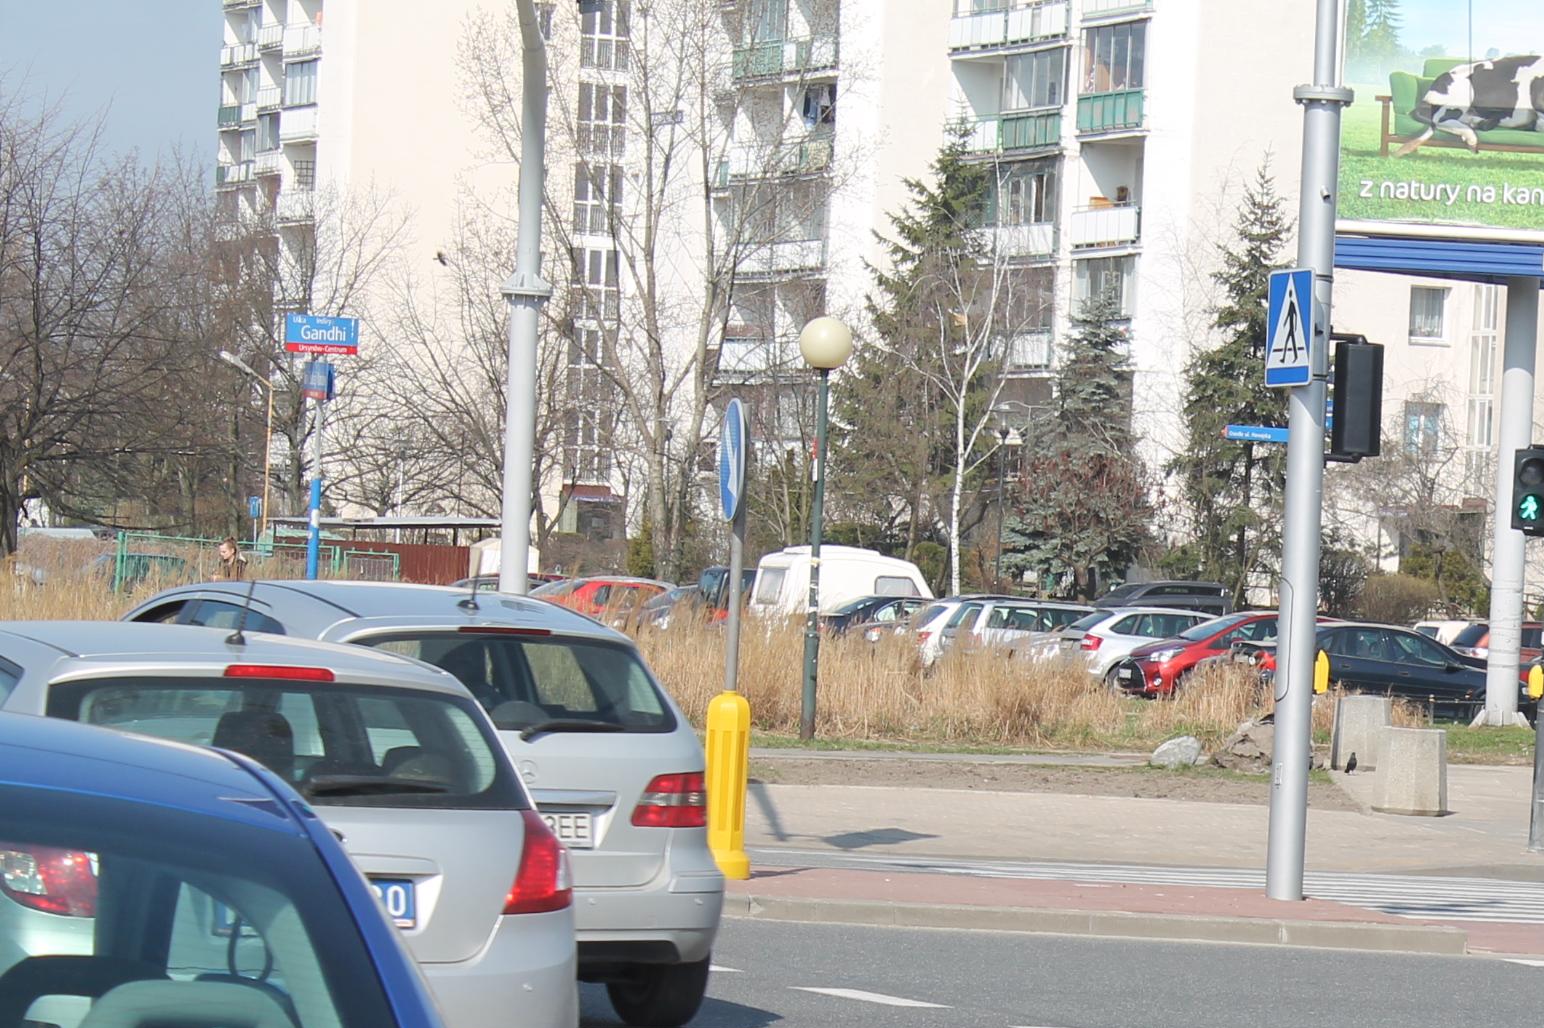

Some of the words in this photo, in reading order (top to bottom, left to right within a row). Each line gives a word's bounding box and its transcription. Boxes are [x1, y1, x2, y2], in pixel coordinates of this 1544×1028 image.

[1360, 180, 1373, 198] z
[1380, 180, 1461, 206] natury
[1466, 185, 1496, 204] na
[300, 325, 347, 342] Gandhi
